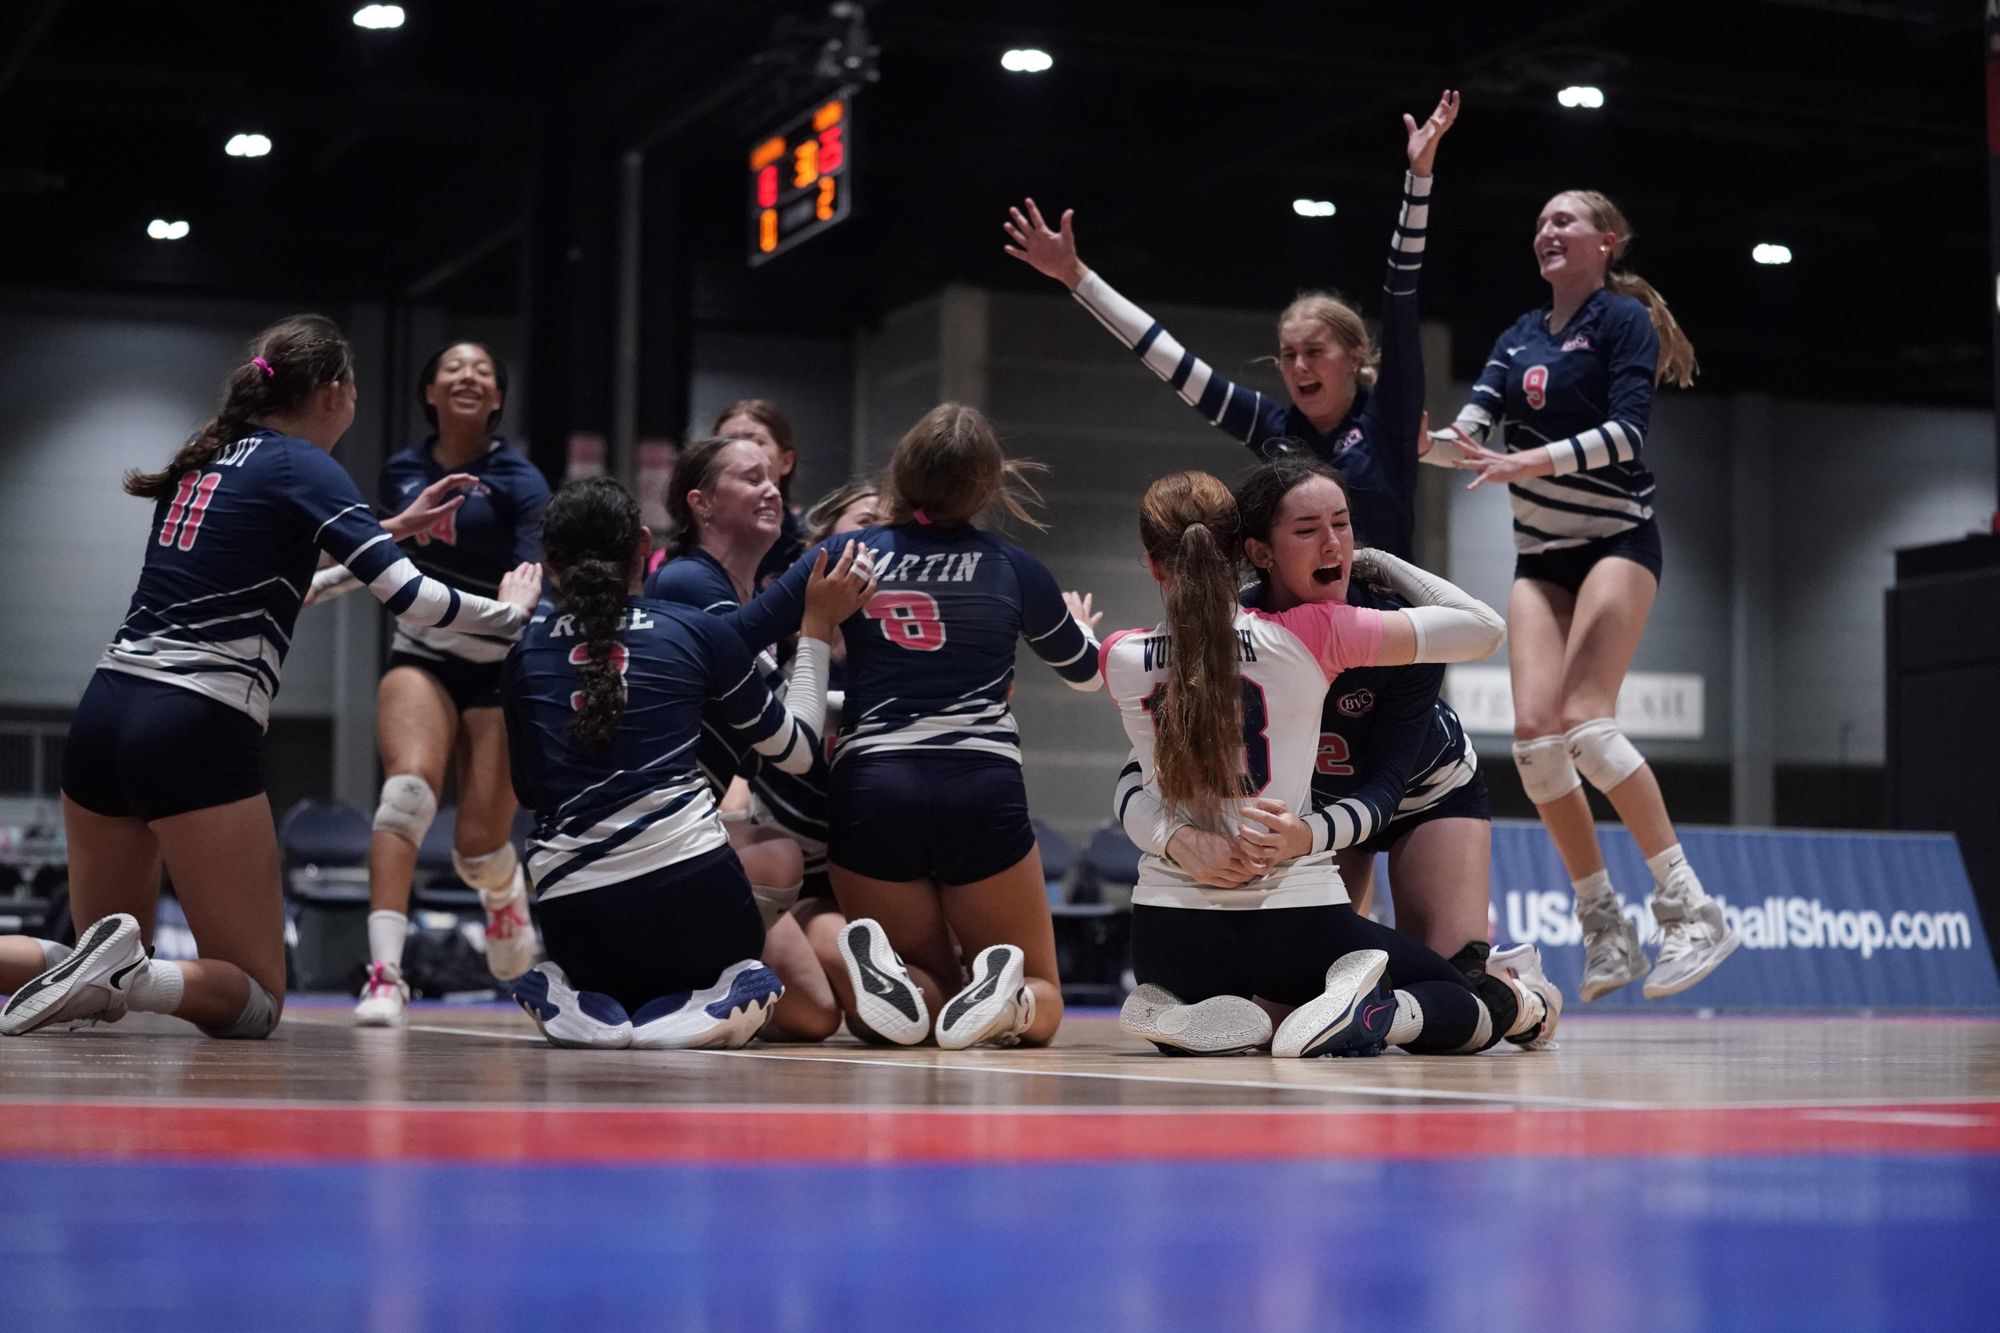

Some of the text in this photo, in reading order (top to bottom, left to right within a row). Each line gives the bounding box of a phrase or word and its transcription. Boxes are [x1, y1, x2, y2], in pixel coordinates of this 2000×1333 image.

[1522, 364, 1549, 411] 9
[158, 469, 222, 552] 11
[865, 548, 983, 582] ARTIN
[549, 606, 655, 638] RE
[862, 589, 947, 652] 8
